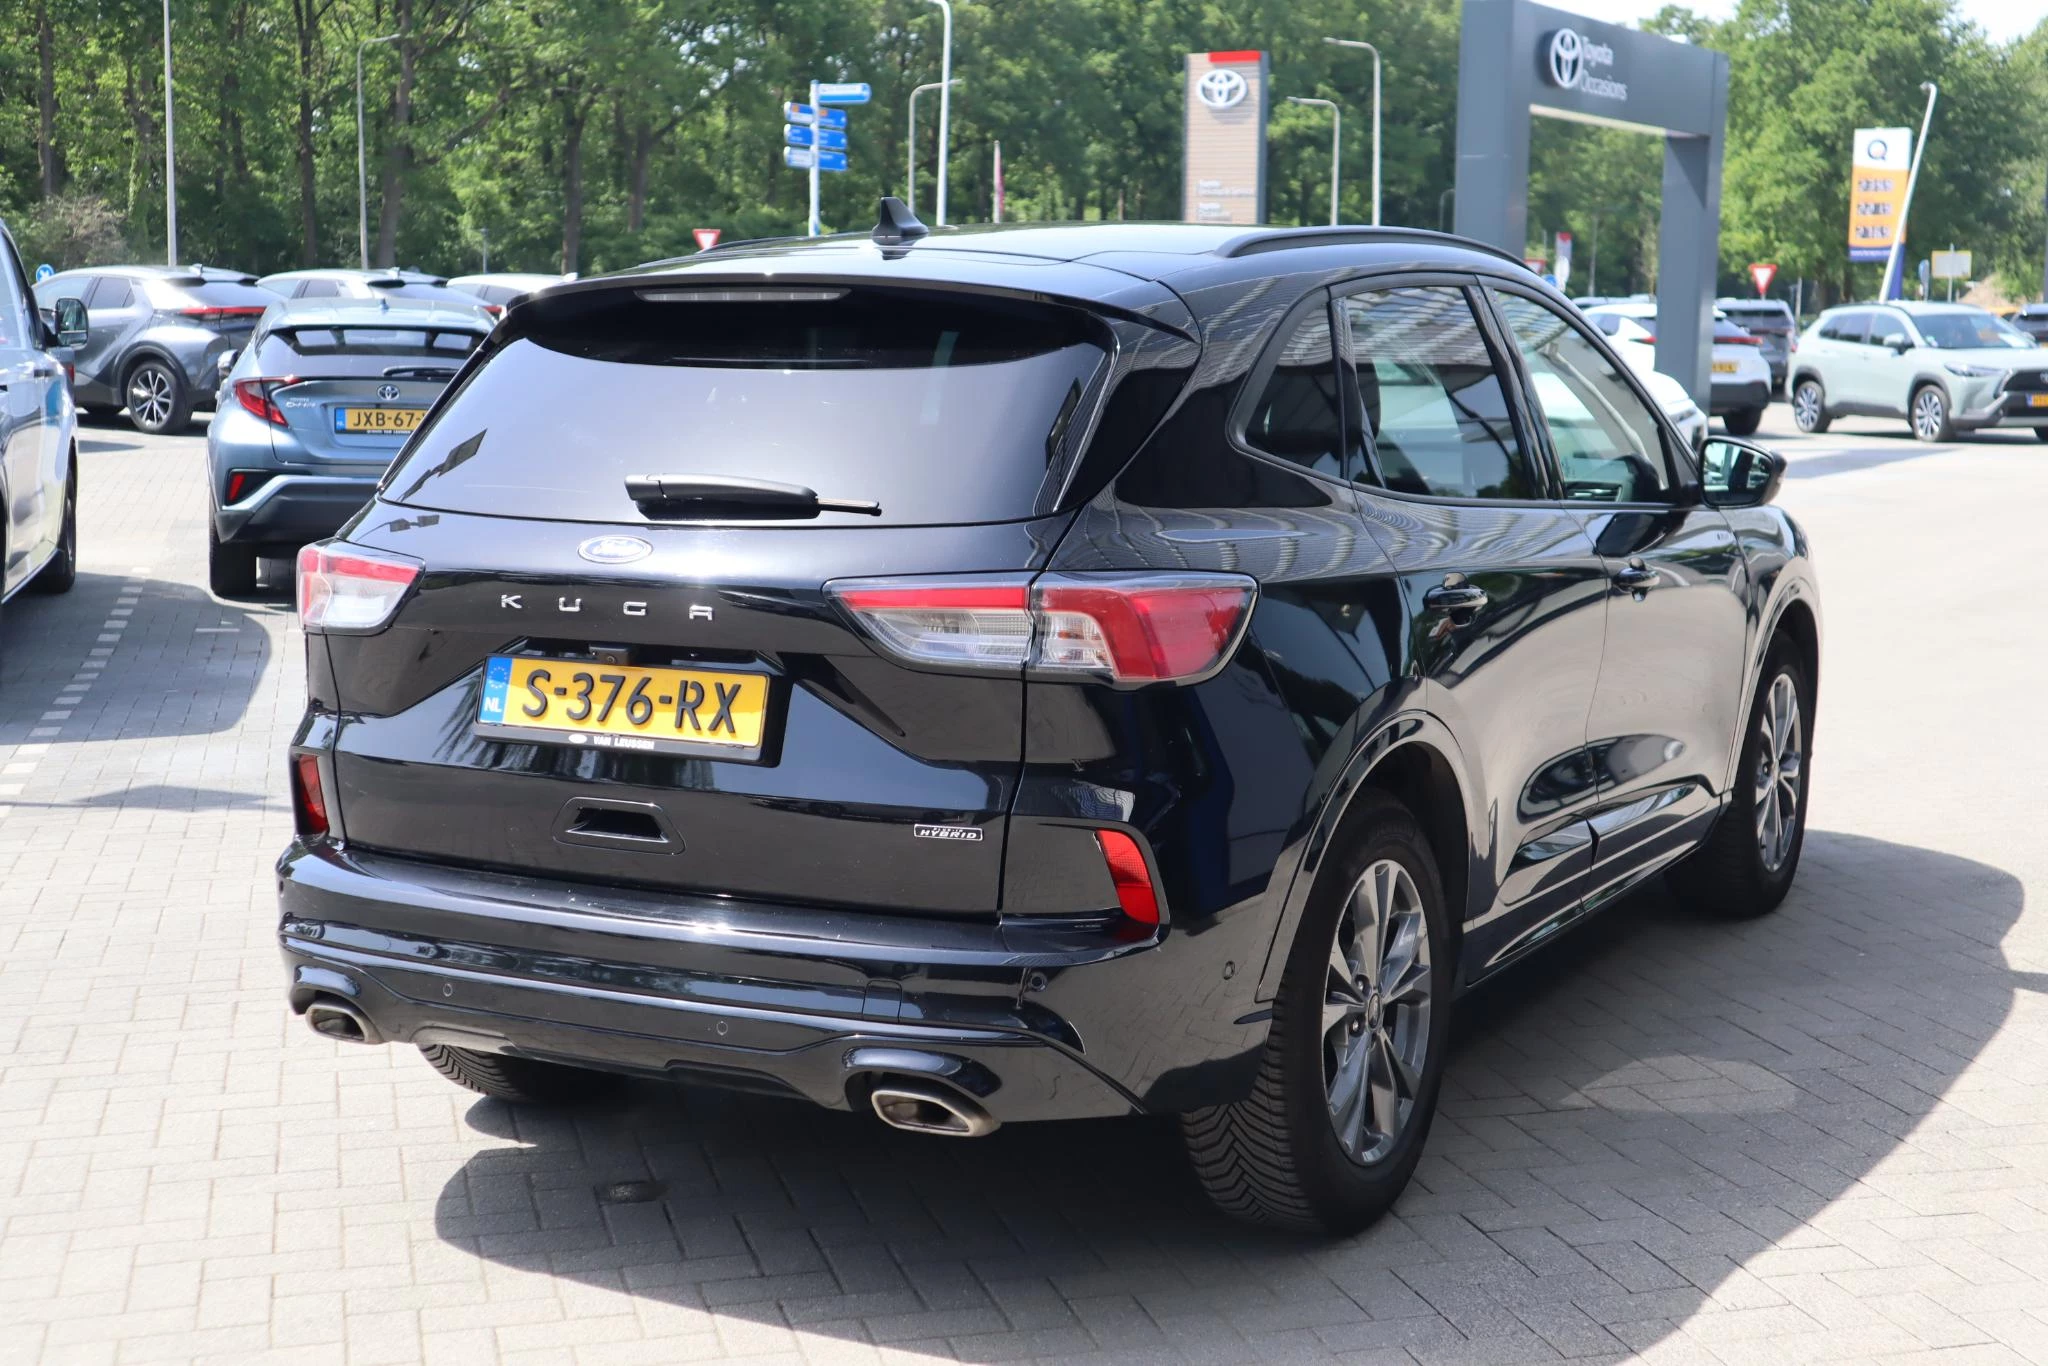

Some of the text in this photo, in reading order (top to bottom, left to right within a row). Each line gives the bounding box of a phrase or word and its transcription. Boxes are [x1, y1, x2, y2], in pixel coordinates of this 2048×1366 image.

[1582, 36, 1613, 67] Toyota
[353, 411, 425, 428] JXB-67-
[500, 594, 713, 621] KUGA
[484, 696, 502, 713] NL
[521, 668, 742, 734] S-376-RX
[920, 829, 977, 839] HYBRID
